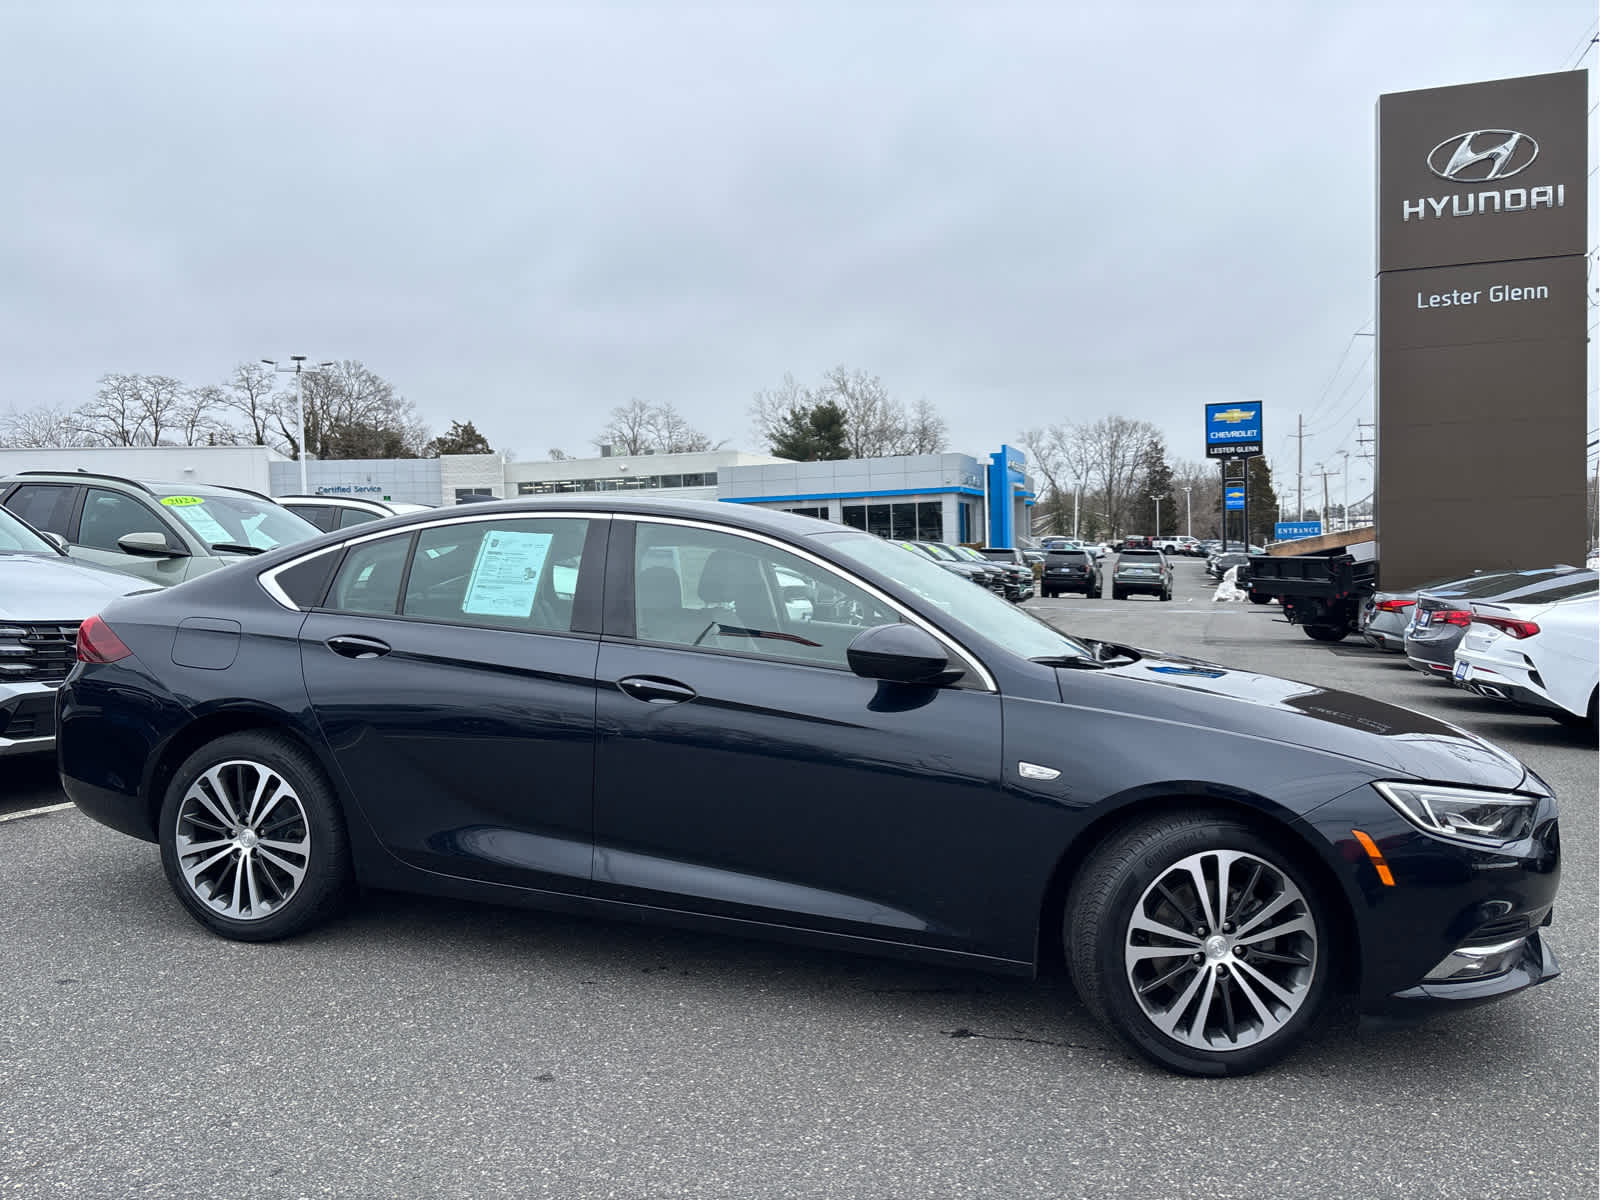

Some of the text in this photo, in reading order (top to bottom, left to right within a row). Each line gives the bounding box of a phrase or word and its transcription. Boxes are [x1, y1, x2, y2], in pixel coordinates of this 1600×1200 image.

[1402, 184, 1565, 222] HYUNDAI
[1417, 284, 1549, 309] Lester Glenn
[1210, 429, 1257, 439] CHEVROLET
[1210, 445, 1259, 455] LESTER GLENN
[318, 485, 382, 494] Certified Service
[1278, 526, 1320, 535] ENTRANCE
